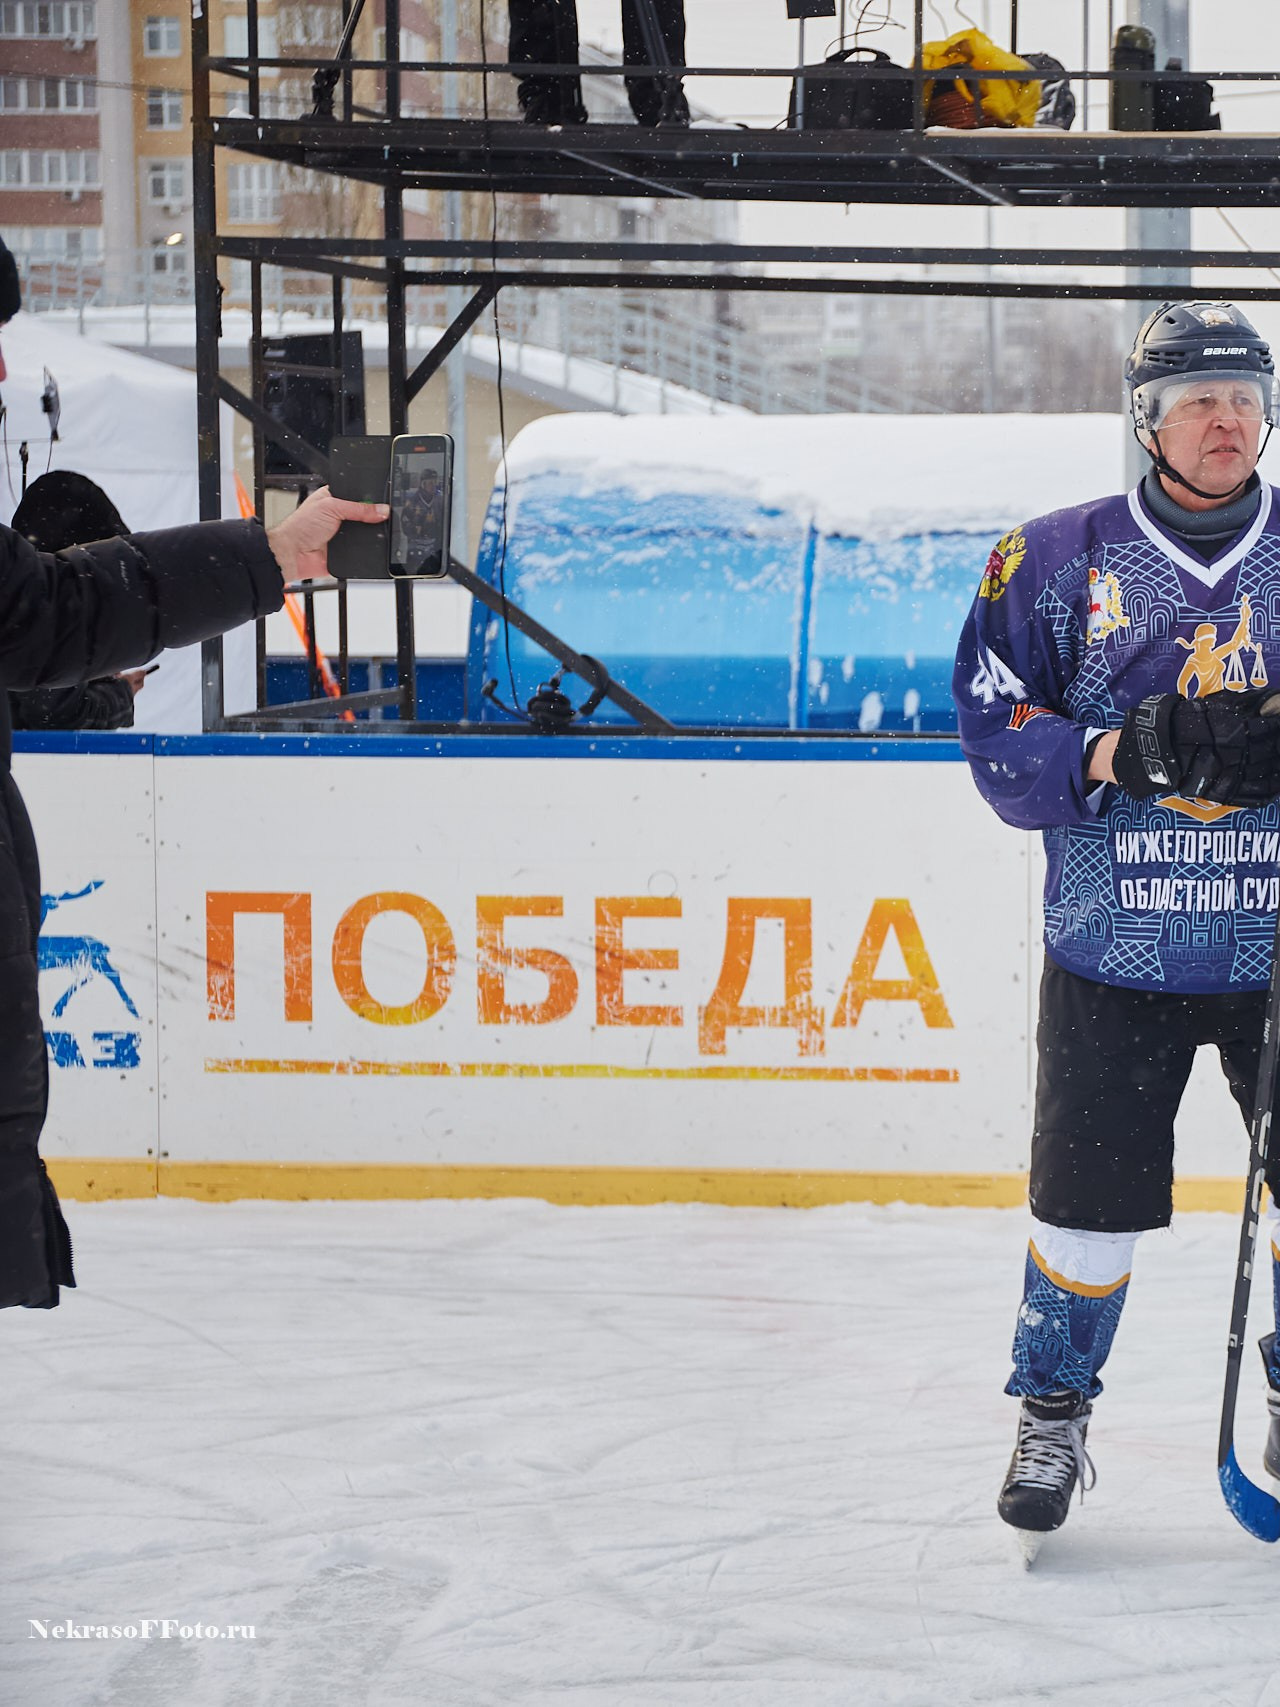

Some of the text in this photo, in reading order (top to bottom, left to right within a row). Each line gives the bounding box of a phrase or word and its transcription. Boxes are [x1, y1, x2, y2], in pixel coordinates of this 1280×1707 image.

[1203, 347, 1248, 356] BAUER
[970, 645, 1029, 705] 44
[1120, 872, 1280, 913] ОБЛАСТНОЙ СУД
[206, 890, 955, 1057] ПОБЕДА
